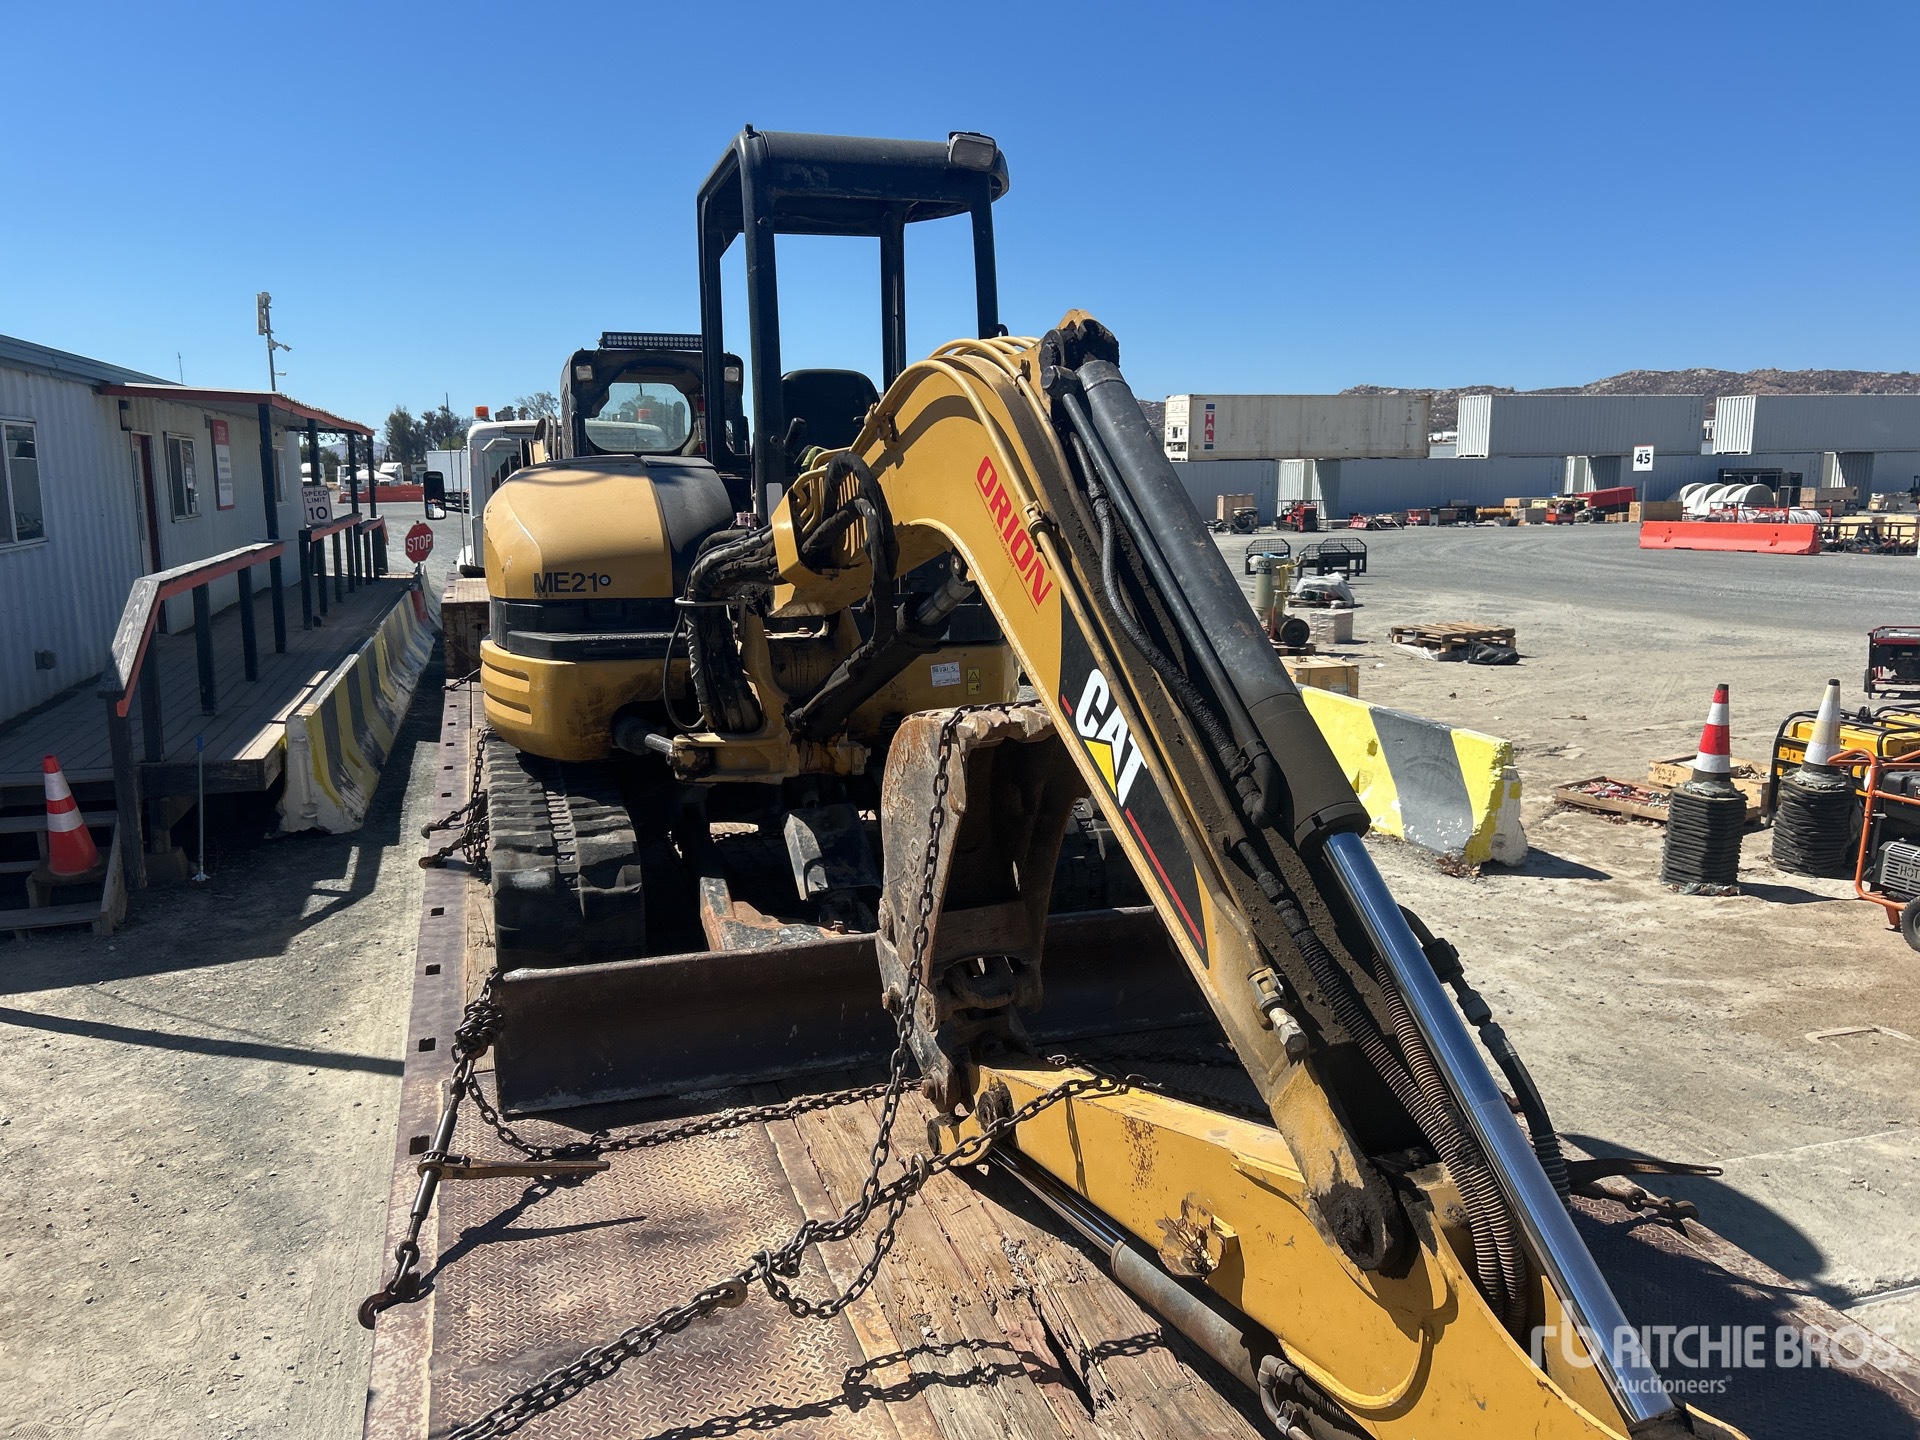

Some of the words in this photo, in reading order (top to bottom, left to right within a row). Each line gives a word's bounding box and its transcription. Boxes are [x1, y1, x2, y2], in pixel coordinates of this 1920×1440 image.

[1204, 411, 1214, 443] TAL
[1636, 453, 1650, 465] 45
[303, 489, 327, 498] SPEED
[308, 506, 328, 520] 10
[977, 456, 1053, 606] ORION
[407, 534, 432, 553] STOP
[1075, 668, 1148, 807] CAT
[1899, 865, 1920, 879] HOT
